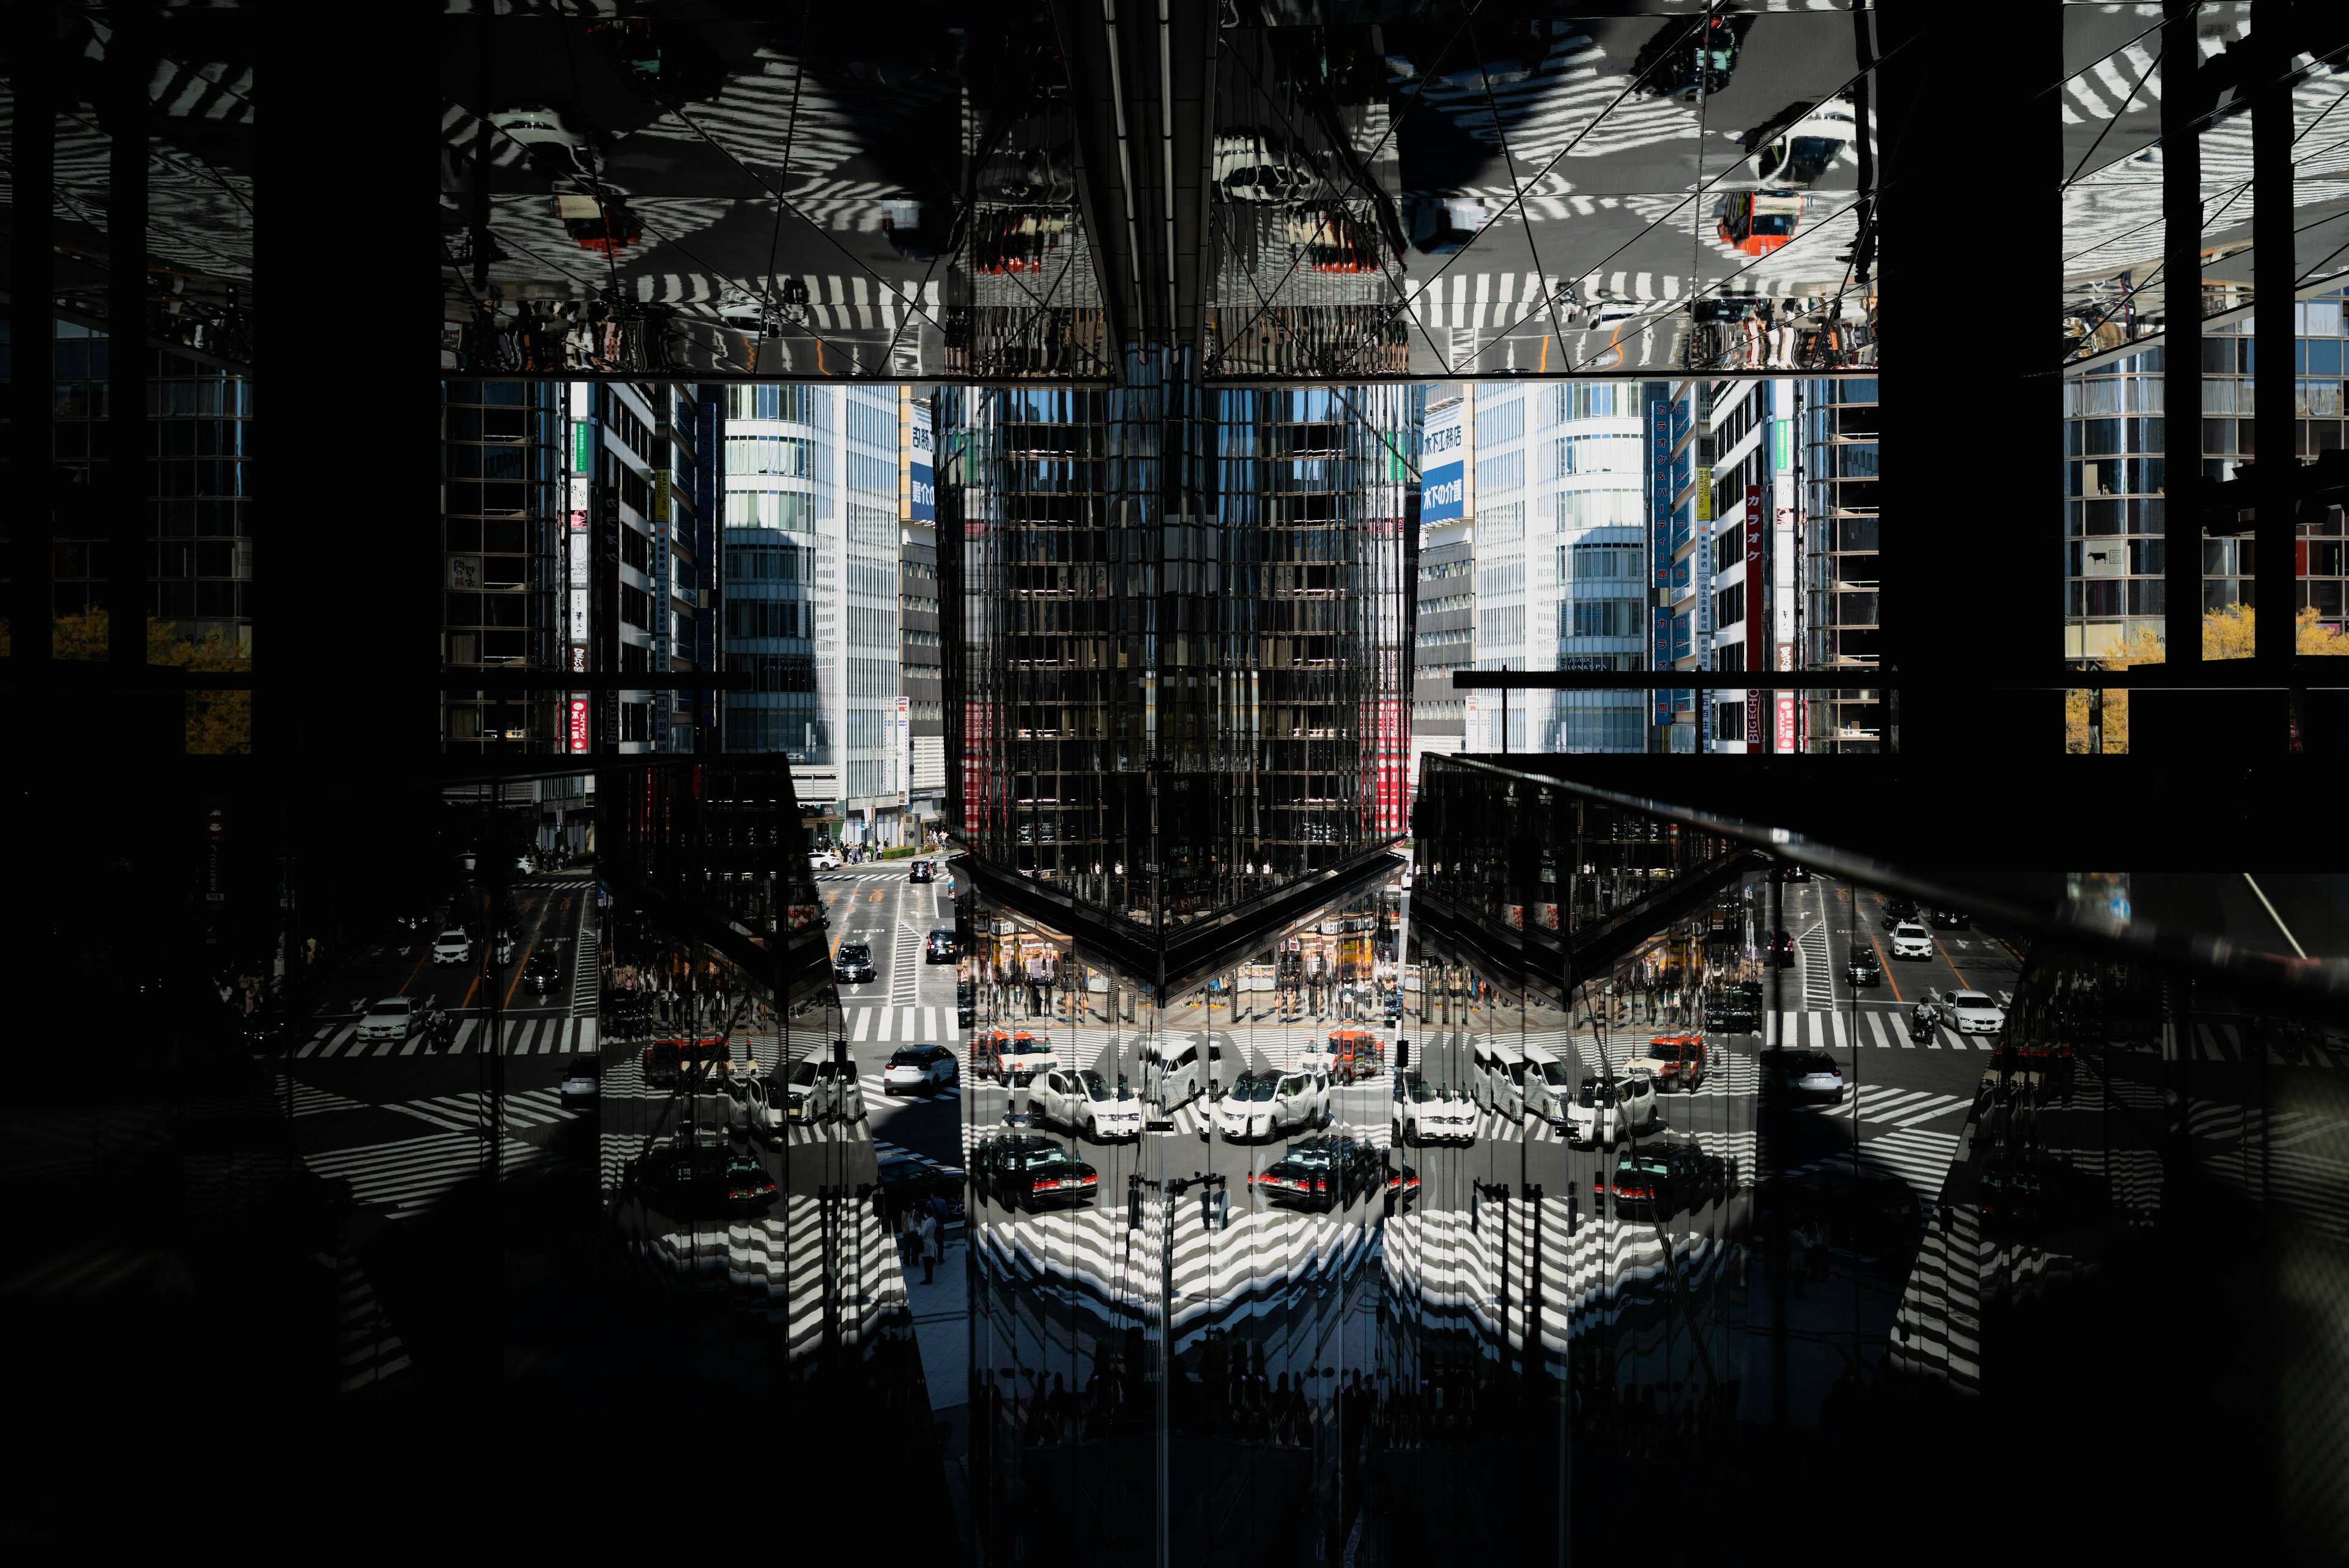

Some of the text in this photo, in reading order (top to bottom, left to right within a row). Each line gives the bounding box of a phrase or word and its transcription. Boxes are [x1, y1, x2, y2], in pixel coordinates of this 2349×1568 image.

[1425, 425, 1461, 456] 木下工務店
[1423, 479, 1463, 510] 木下の介護
[1657, 405, 1668, 579] カラオケ&パーティー館
[1747, 496, 1761, 561] カラオケ
[1657, 619, 1668, 713] カラオ館
[1748, 689, 1760, 743] BIG ECHO
[1785, 710, 1794, 738] 不二家
